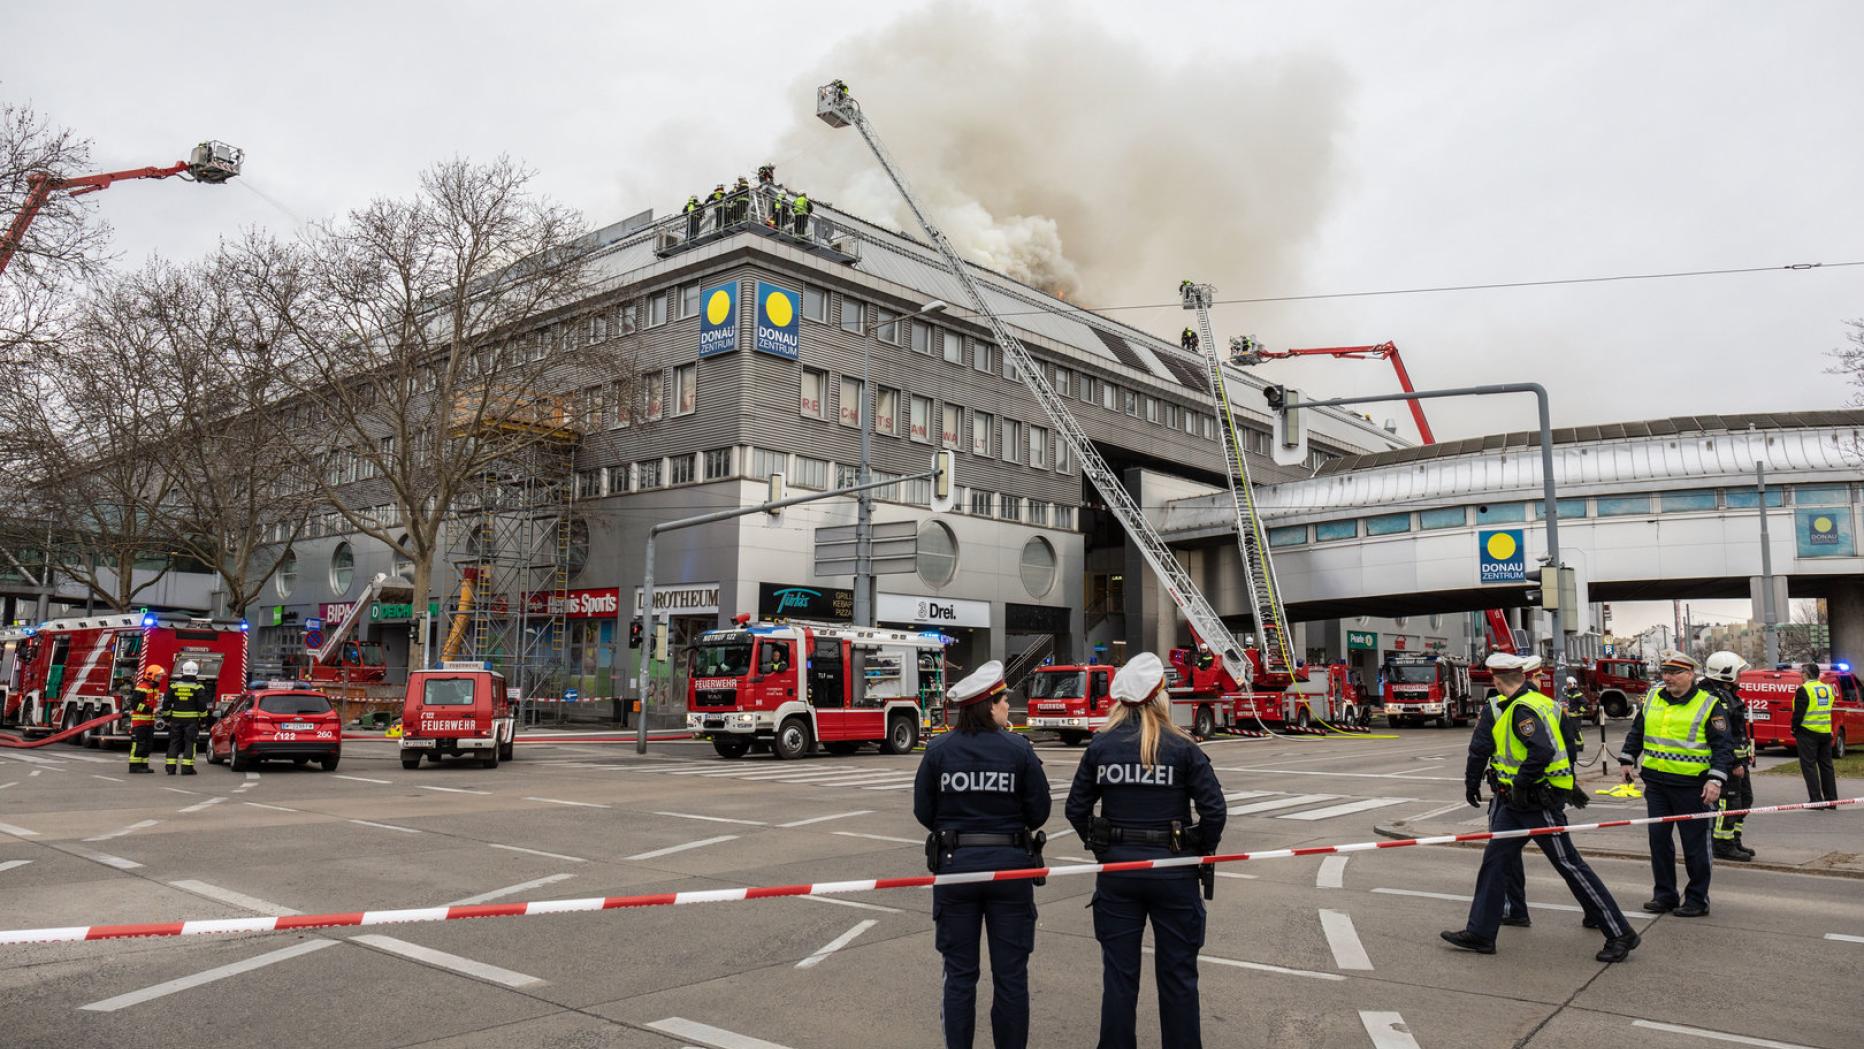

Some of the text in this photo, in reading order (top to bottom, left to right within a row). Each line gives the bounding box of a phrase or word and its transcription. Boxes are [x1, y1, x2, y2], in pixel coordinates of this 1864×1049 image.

[701, 326, 735, 345] DONAU
[758, 325, 798, 347] DONAU
[700, 338, 734, 354] ZENTRUM
[758, 338, 798, 356] ZENTRUM
[1482, 562, 1523, 573] DONAU
[1482, 572, 1524, 580] ZENTRUM
[581, 592, 617, 617] Sports
[929, 602, 957, 620] Drei.
[835, 608, 853, 618] PIZZA
[703, 634, 725, 642] NOTRUF
[695, 679, 737, 689] FEUERWEHR
[1748, 699, 1769, 710] 122
[421, 720, 476, 731] FEUERWEHR
[280, 732, 296, 740] 122
[1096, 763, 1174, 785] POLIZEI
[940, 771, 1016, 793] POLIZEI
